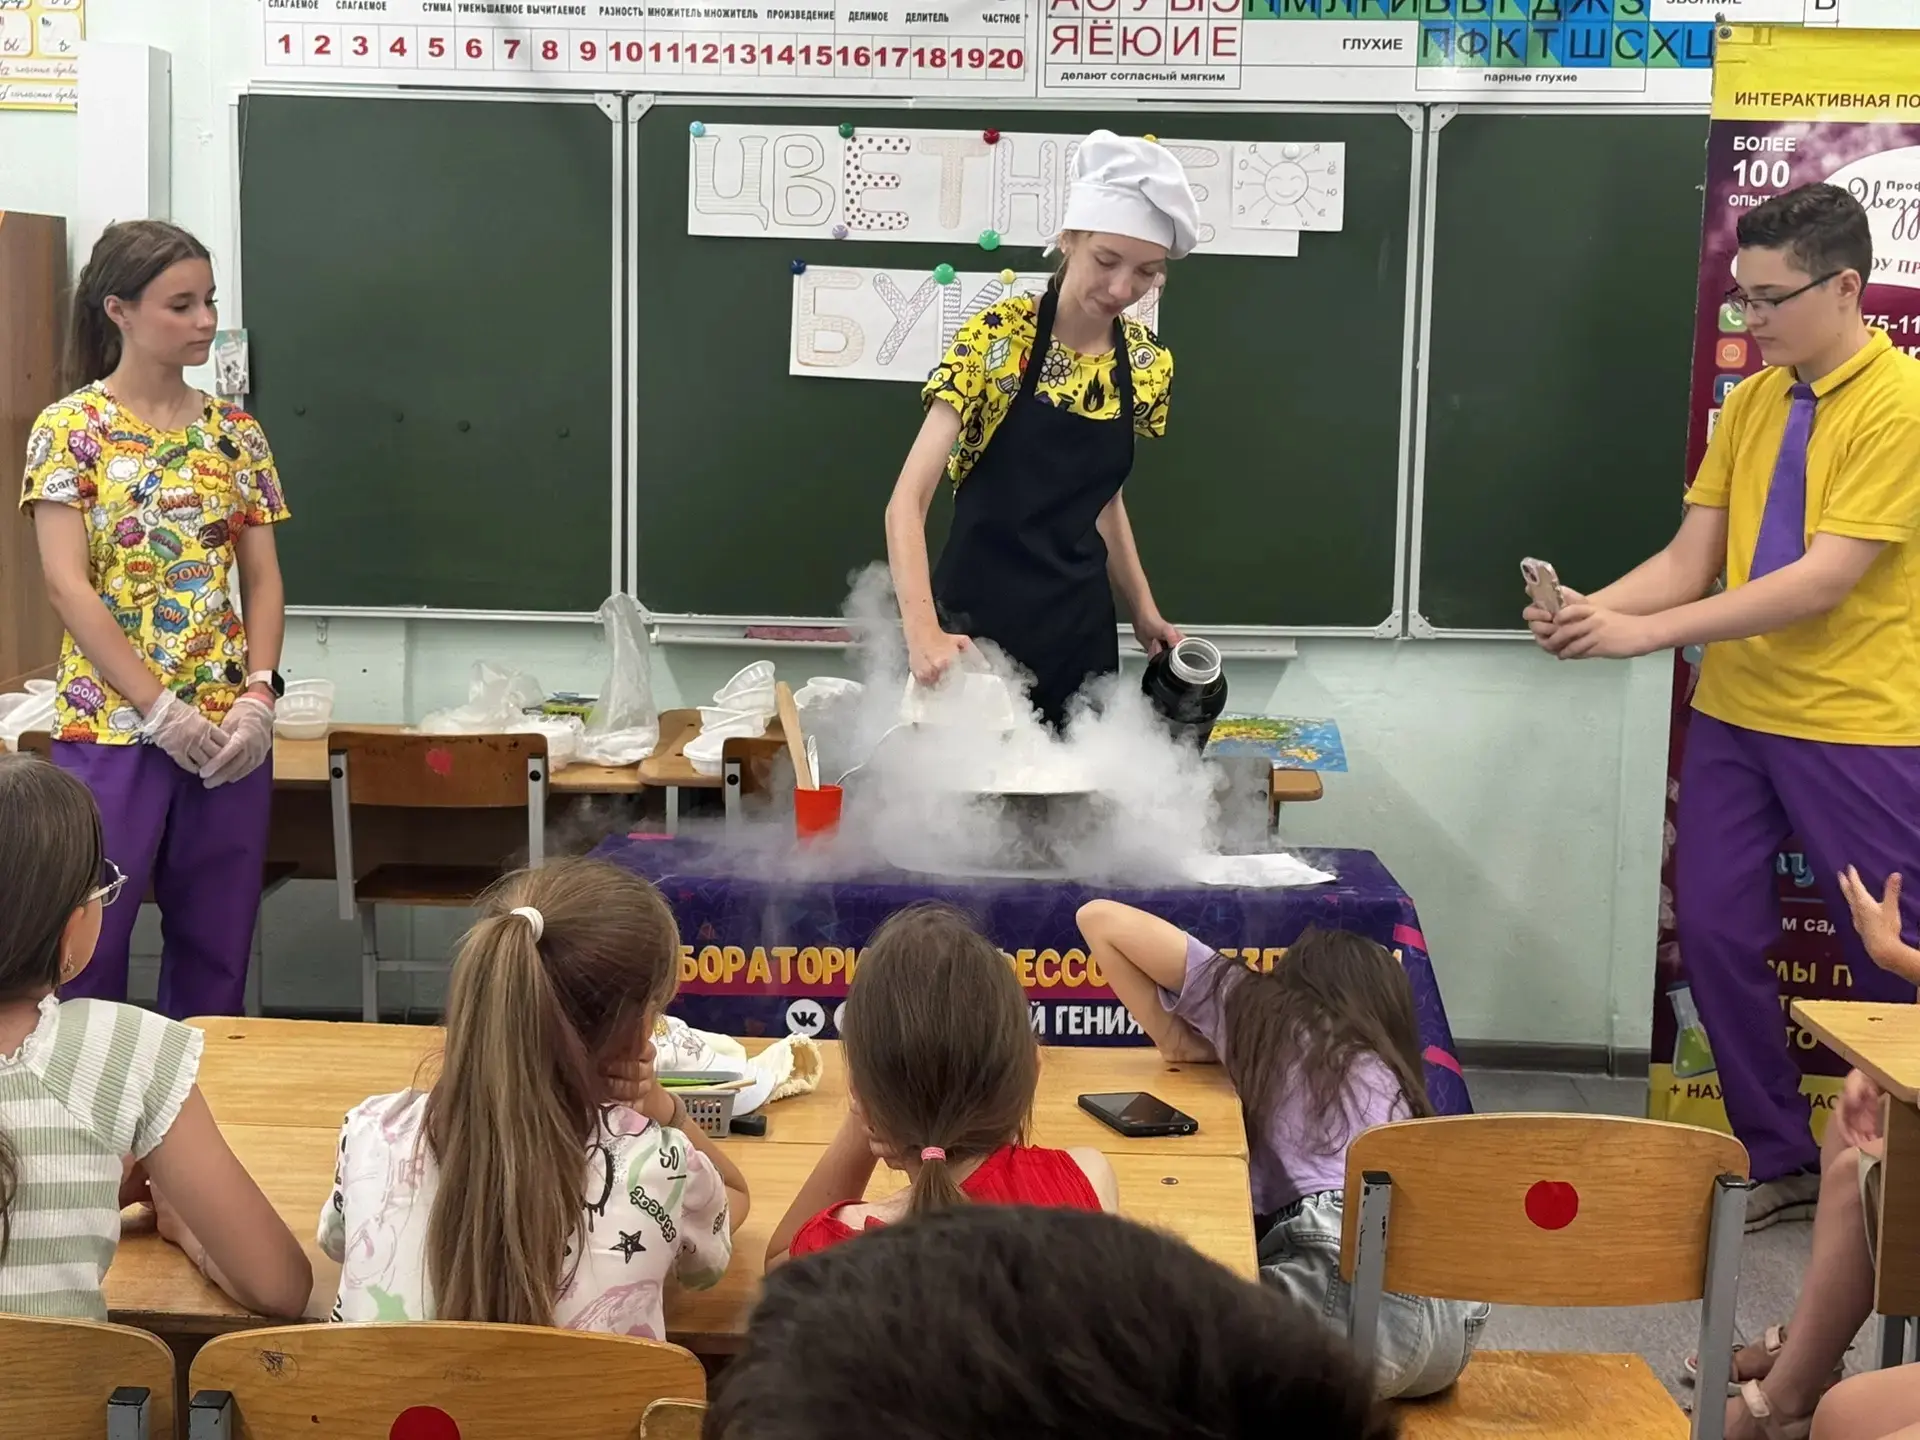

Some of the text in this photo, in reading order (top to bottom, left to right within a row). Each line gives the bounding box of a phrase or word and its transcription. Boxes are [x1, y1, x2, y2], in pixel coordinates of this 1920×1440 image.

[336, 1, 387, 11] СЛАГАЕМОЕ
[422, 3, 452, 13] СУММА
[458, 3, 524, 15] УМЕНЬШАЕМОЕ
[527, 5, 587, 16] ВЫЧИТАЕМОЕ
[599, 7, 644, 17] РАЗНОСТЬ
[648, 8, 702, 19] МНОЖИТЕЛЬ
[704, 9, 758, 19] МНОЖИТЕЛЬ
[767, 10, 835, 21] ПРОИЗВЕДЕНИЕ
[848, 11, 888, 22] ДЕЛИМОЕ
[905, 12, 949, 24] ДЕЛИТЕЛЬ
[982, 13, 1021, 24] ЧАСТНОЕ
[1050, 20, 1237, 57] Я Ё Ю И Е
[1342, 38, 1403, 51] ГЛУХИЕ
[1456, 28, 1488, 59] Ф
[1496, 29, 1520, 58] К
[1532, 29, 1559, 58] Т
[1570, 29, 1606, 59] Ш
[1615, 29, 1644, 60] С
[1650, 29, 1679, 59] Х
[278, 34, 1024, 69] 1 2 3 4 5 6 7 8 9 10 11 12 13 14 15 16 17 18 19 20
[1061, 71, 1225, 83] делают согласный мягким
[1484, 72, 1578, 85] парные глухие
[1734, 92, 1890, 108] ИНТЕРАКТИВНАЯ
[1733, 137, 1796, 152] БОЛЕЕ
[1732, 159, 1790, 188] 100
[692, 133, 1220, 244] ЦВЕТН
[1728, 194, 1773, 207] ОПЫТ
[165, 563, 212, 589] POW
[158, 604, 185, 625] POW
[679, 945, 870, 984] БОРАТОРИ
